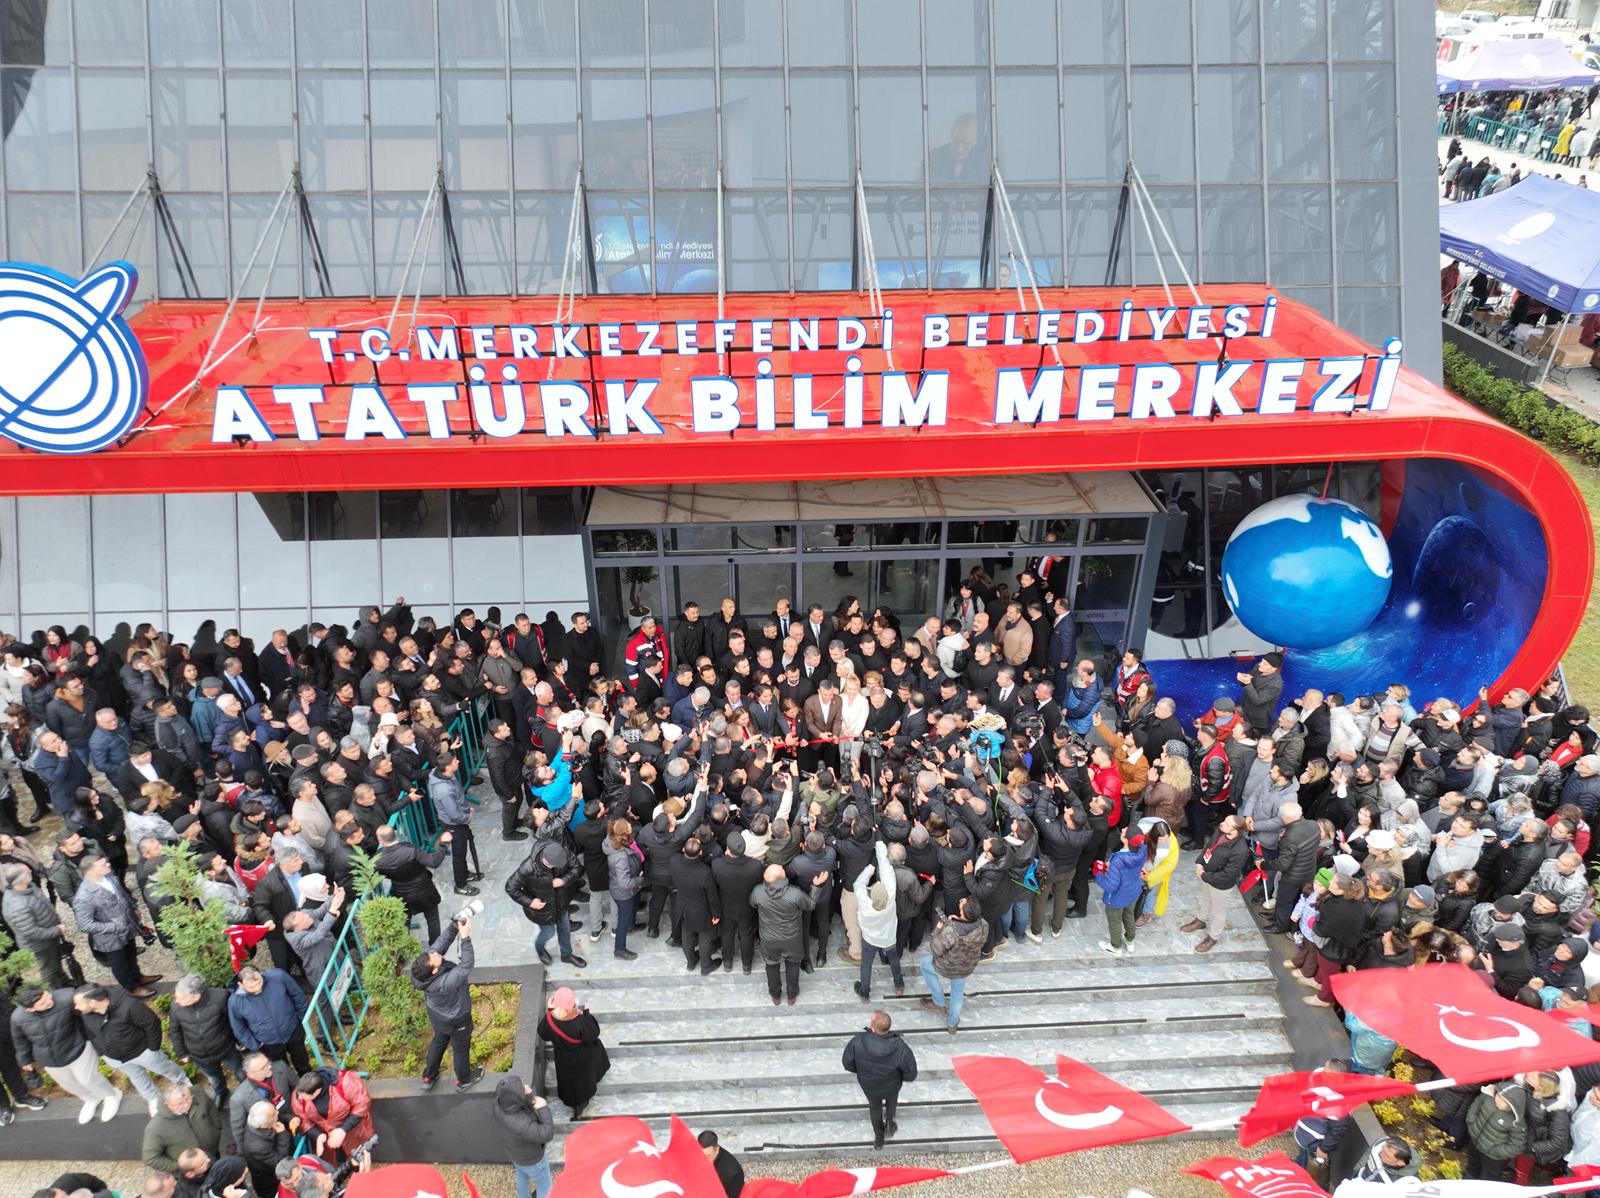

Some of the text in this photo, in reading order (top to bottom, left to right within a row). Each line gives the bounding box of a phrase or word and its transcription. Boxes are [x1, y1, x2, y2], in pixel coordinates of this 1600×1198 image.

[923, 296, 1278, 348] BELEDİYESİ
[211, 336, 1403, 442] ATATÜRK BİLİM MERKEZİ
